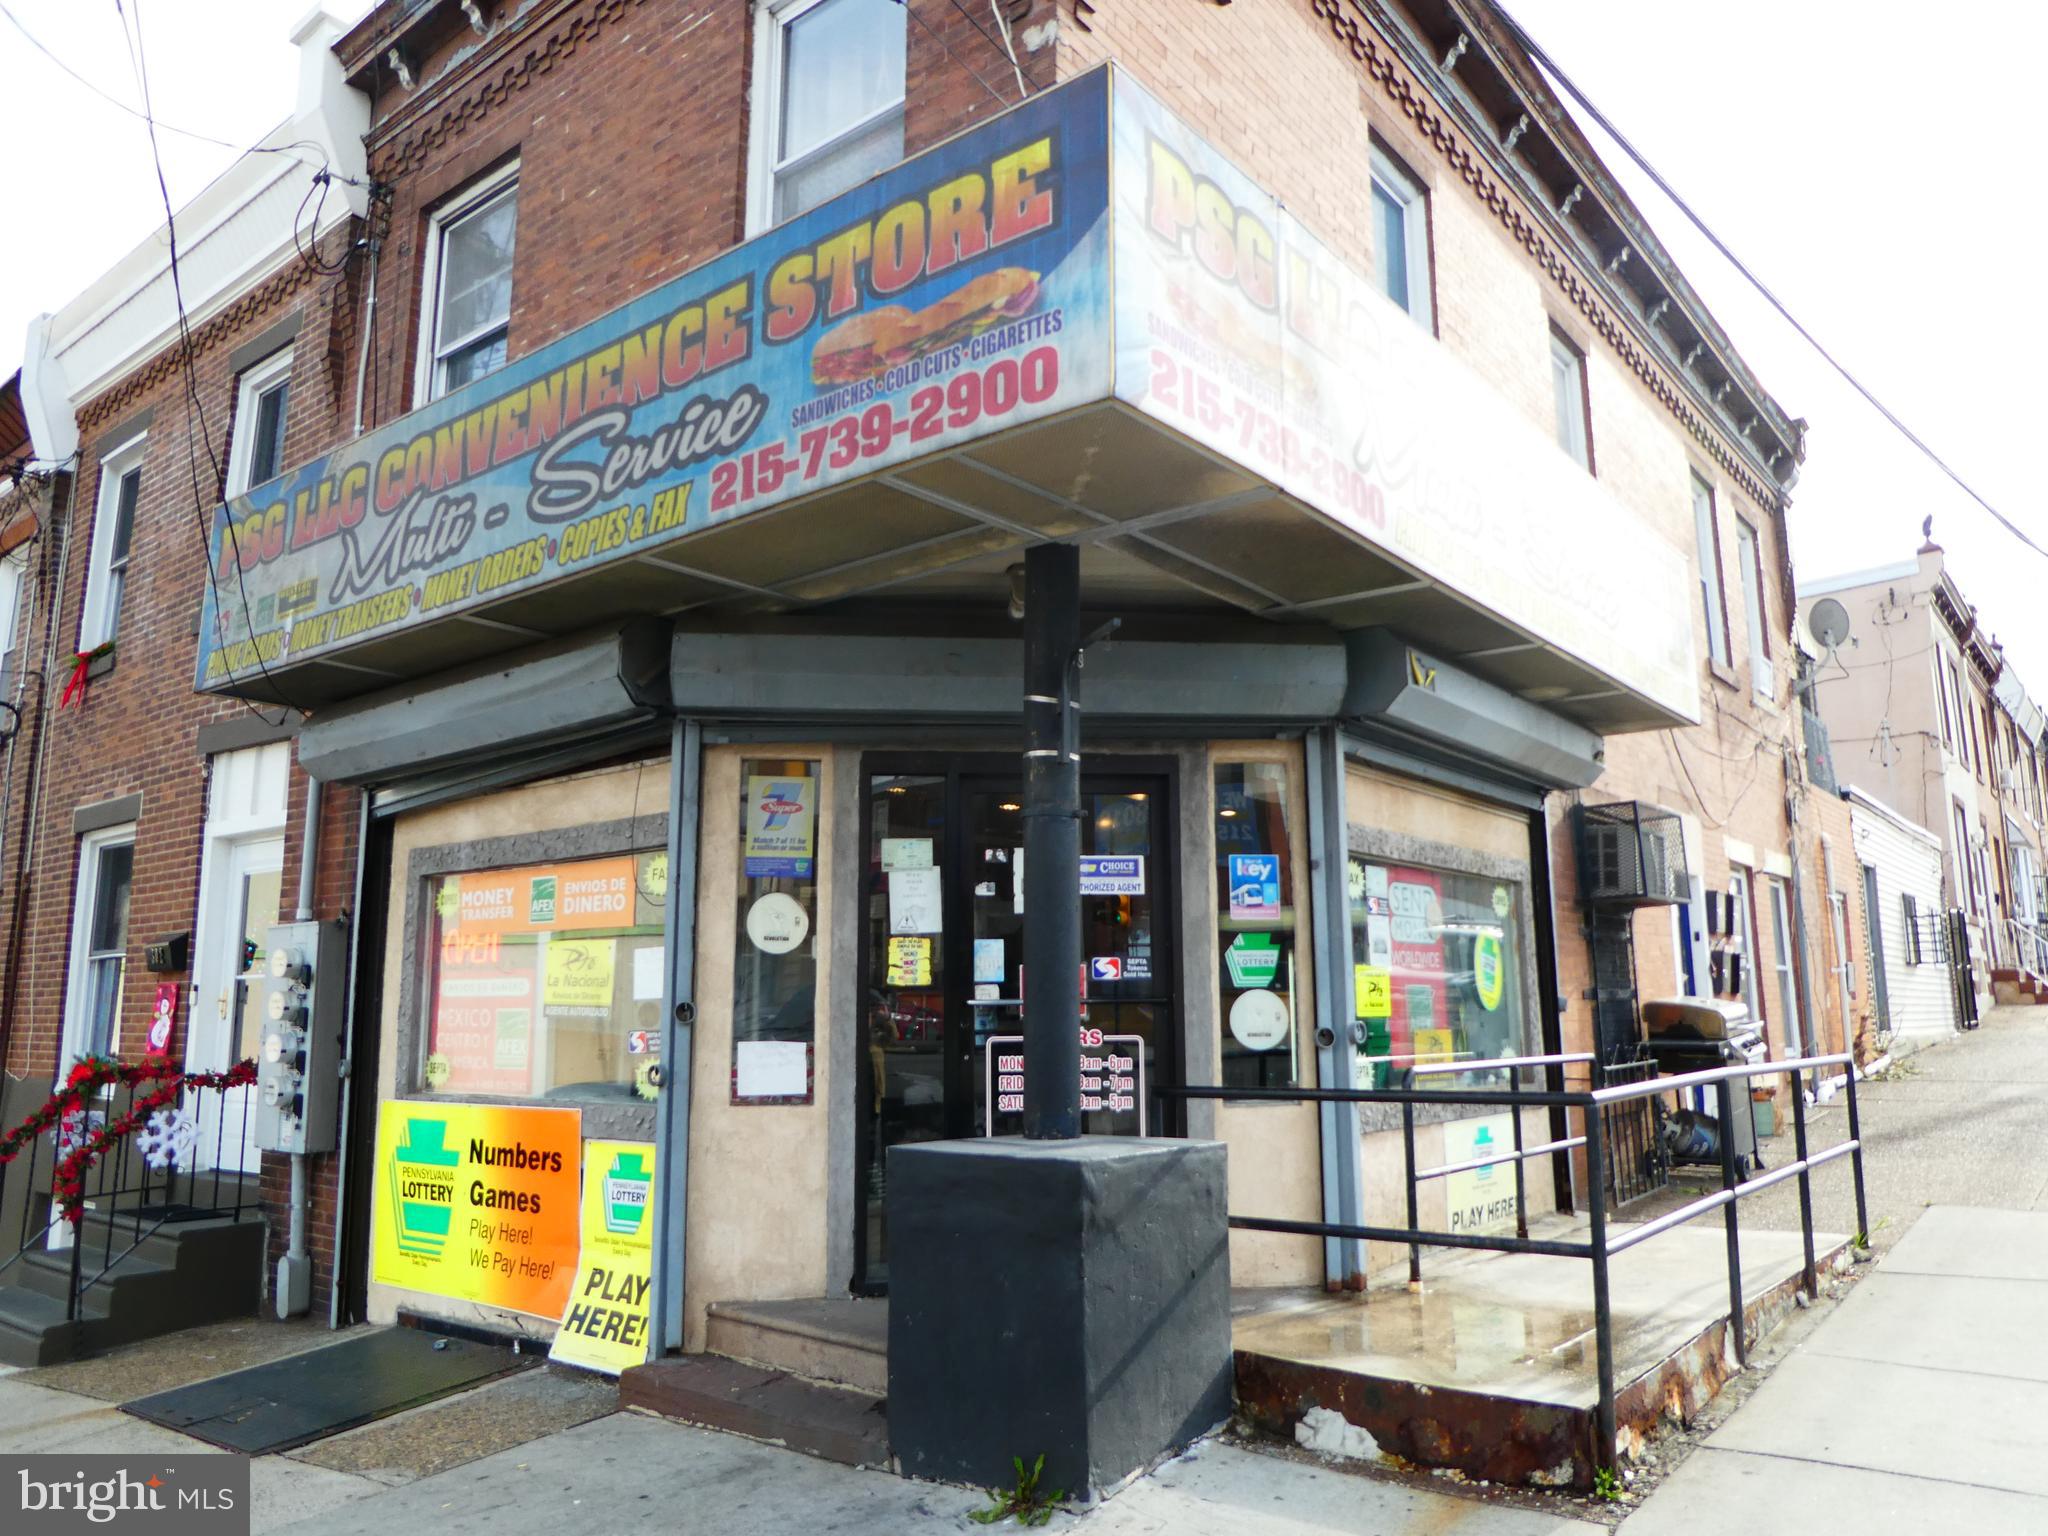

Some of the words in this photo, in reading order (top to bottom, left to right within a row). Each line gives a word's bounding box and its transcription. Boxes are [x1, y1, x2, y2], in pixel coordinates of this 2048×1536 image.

[1147, 133, 1279, 315] PSG
[218, 502, 287, 580] PSG
[290, 461, 369, 551] LLC
[375, 271, 755, 517] CONVENIENCE
[763, 132, 1058, 345] STORE
[792, 380, 874, 428] SANDWICHES
[886, 362, 921, 392] COLD
[923, 347, 961, 378] CUTS
[972, 309, 1062, 360] CIGARETTES
[710, 345, 1060, 512] 215-739-2900
[288, 611, 336, 657] MONEY
[333, 582, 413, 642] TRANSFERS
[421, 560, 478, 612] MONEY
[477, 534, 548, 594] ORDERS
[557, 504, 630, 566] COPIES
[630, 505, 646, 543] &
[648, 479, 694, 535] FAX
[652, 867, 666, 881] FA
[1100, 862, 1135, 873] CHOICE
[565, 878, 608, 896] ENVIOS
[610, 876, 627, 892] DE
[1117, 883, 1142, 892] AGENT
[462, 887, 515, 908] MONEY
[532, 899, 554, 913] AFEX
[563, 893, 626, 915] DINERO
[462, 906, 514, 921] TRANSFER
[1236, 958, 1275, 966] LOTTERY
[547, 974, 559, 987] La
[563, 973, 610, 988] Nacional
[496, 1038, 527, 1057] AFEX
[469, 1138, 562, 1173] Numbers
[402, 1166, 455, 1182] PENNSYLVANIA
[402, 1181, 454, 1203] LOTTERY
[469, 1180, 541, 1214] Games
[611, 1190, 647, 1204] LOTTERY
[1451, 1205, 1484, 1232] PLAY
[470, 1218, 496, 1241] Play
[500, 1222, 533, 1246] Here!
[470, 1248, 489, 1270] We
[493, 1251, 515, 1279] Pay
[520, 1255, 555, 1281] Here!
[584, 1268, 650, 1307] PLAY
[564, 1302, 649, 1347] HERE!
